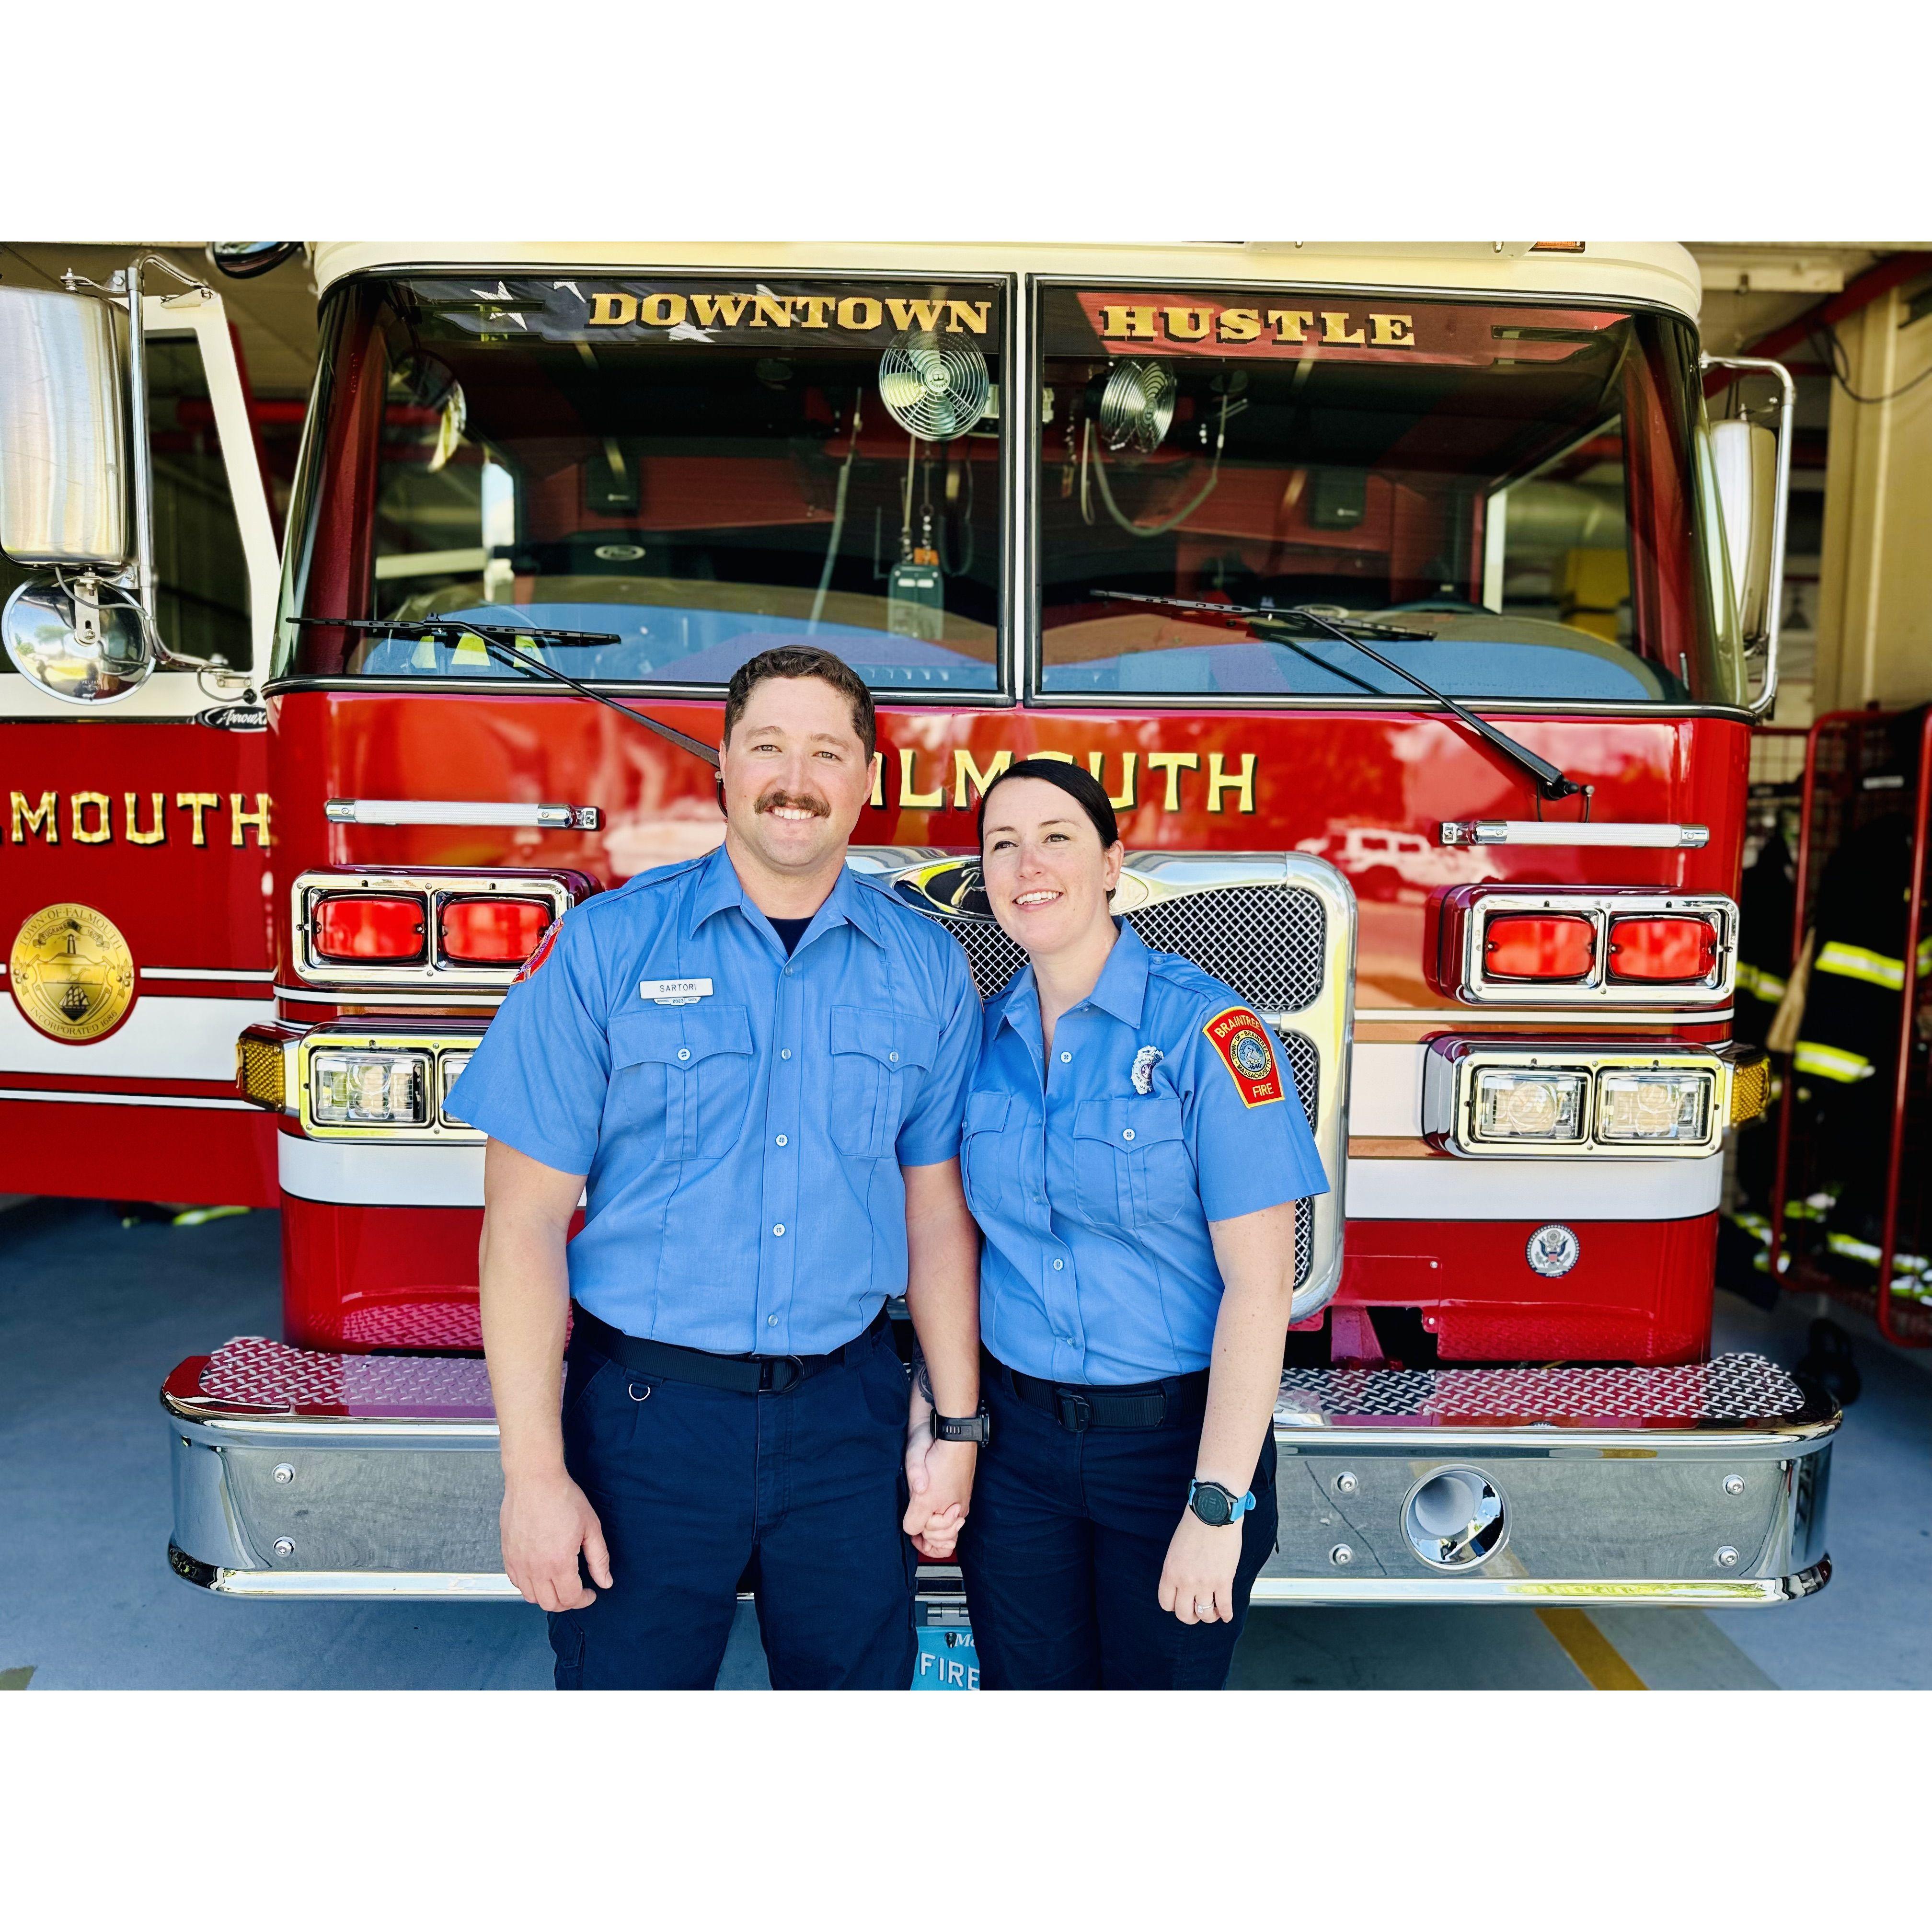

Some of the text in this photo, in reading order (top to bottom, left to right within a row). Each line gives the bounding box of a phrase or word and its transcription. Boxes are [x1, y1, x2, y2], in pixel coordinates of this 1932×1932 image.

[588, 293, 1416, 346] DOWNTOWN HUSTLE
[870, 749, 1257, 812] LMUTH
[10, 791, 271, 846] MOUTH
[19, 908, 123, 950] TOWN OF FALMOUTH
[87, 929, 101, 941] 1602
[660, 984, 696, 992] SARTORI
[30, 1007, 118, 1035] INCORPORATED 1686
[1214, 1015, 1261, 1038] BRAINTREE
[1244, 1031, 1268, 1053] BRAINTREE
[1237, 1058, 1271, 1079] MASSACHUSETTS
[1252, 1082, 1274, 1098] FIRE
[921, 1652, 980, 1690] FIRE
